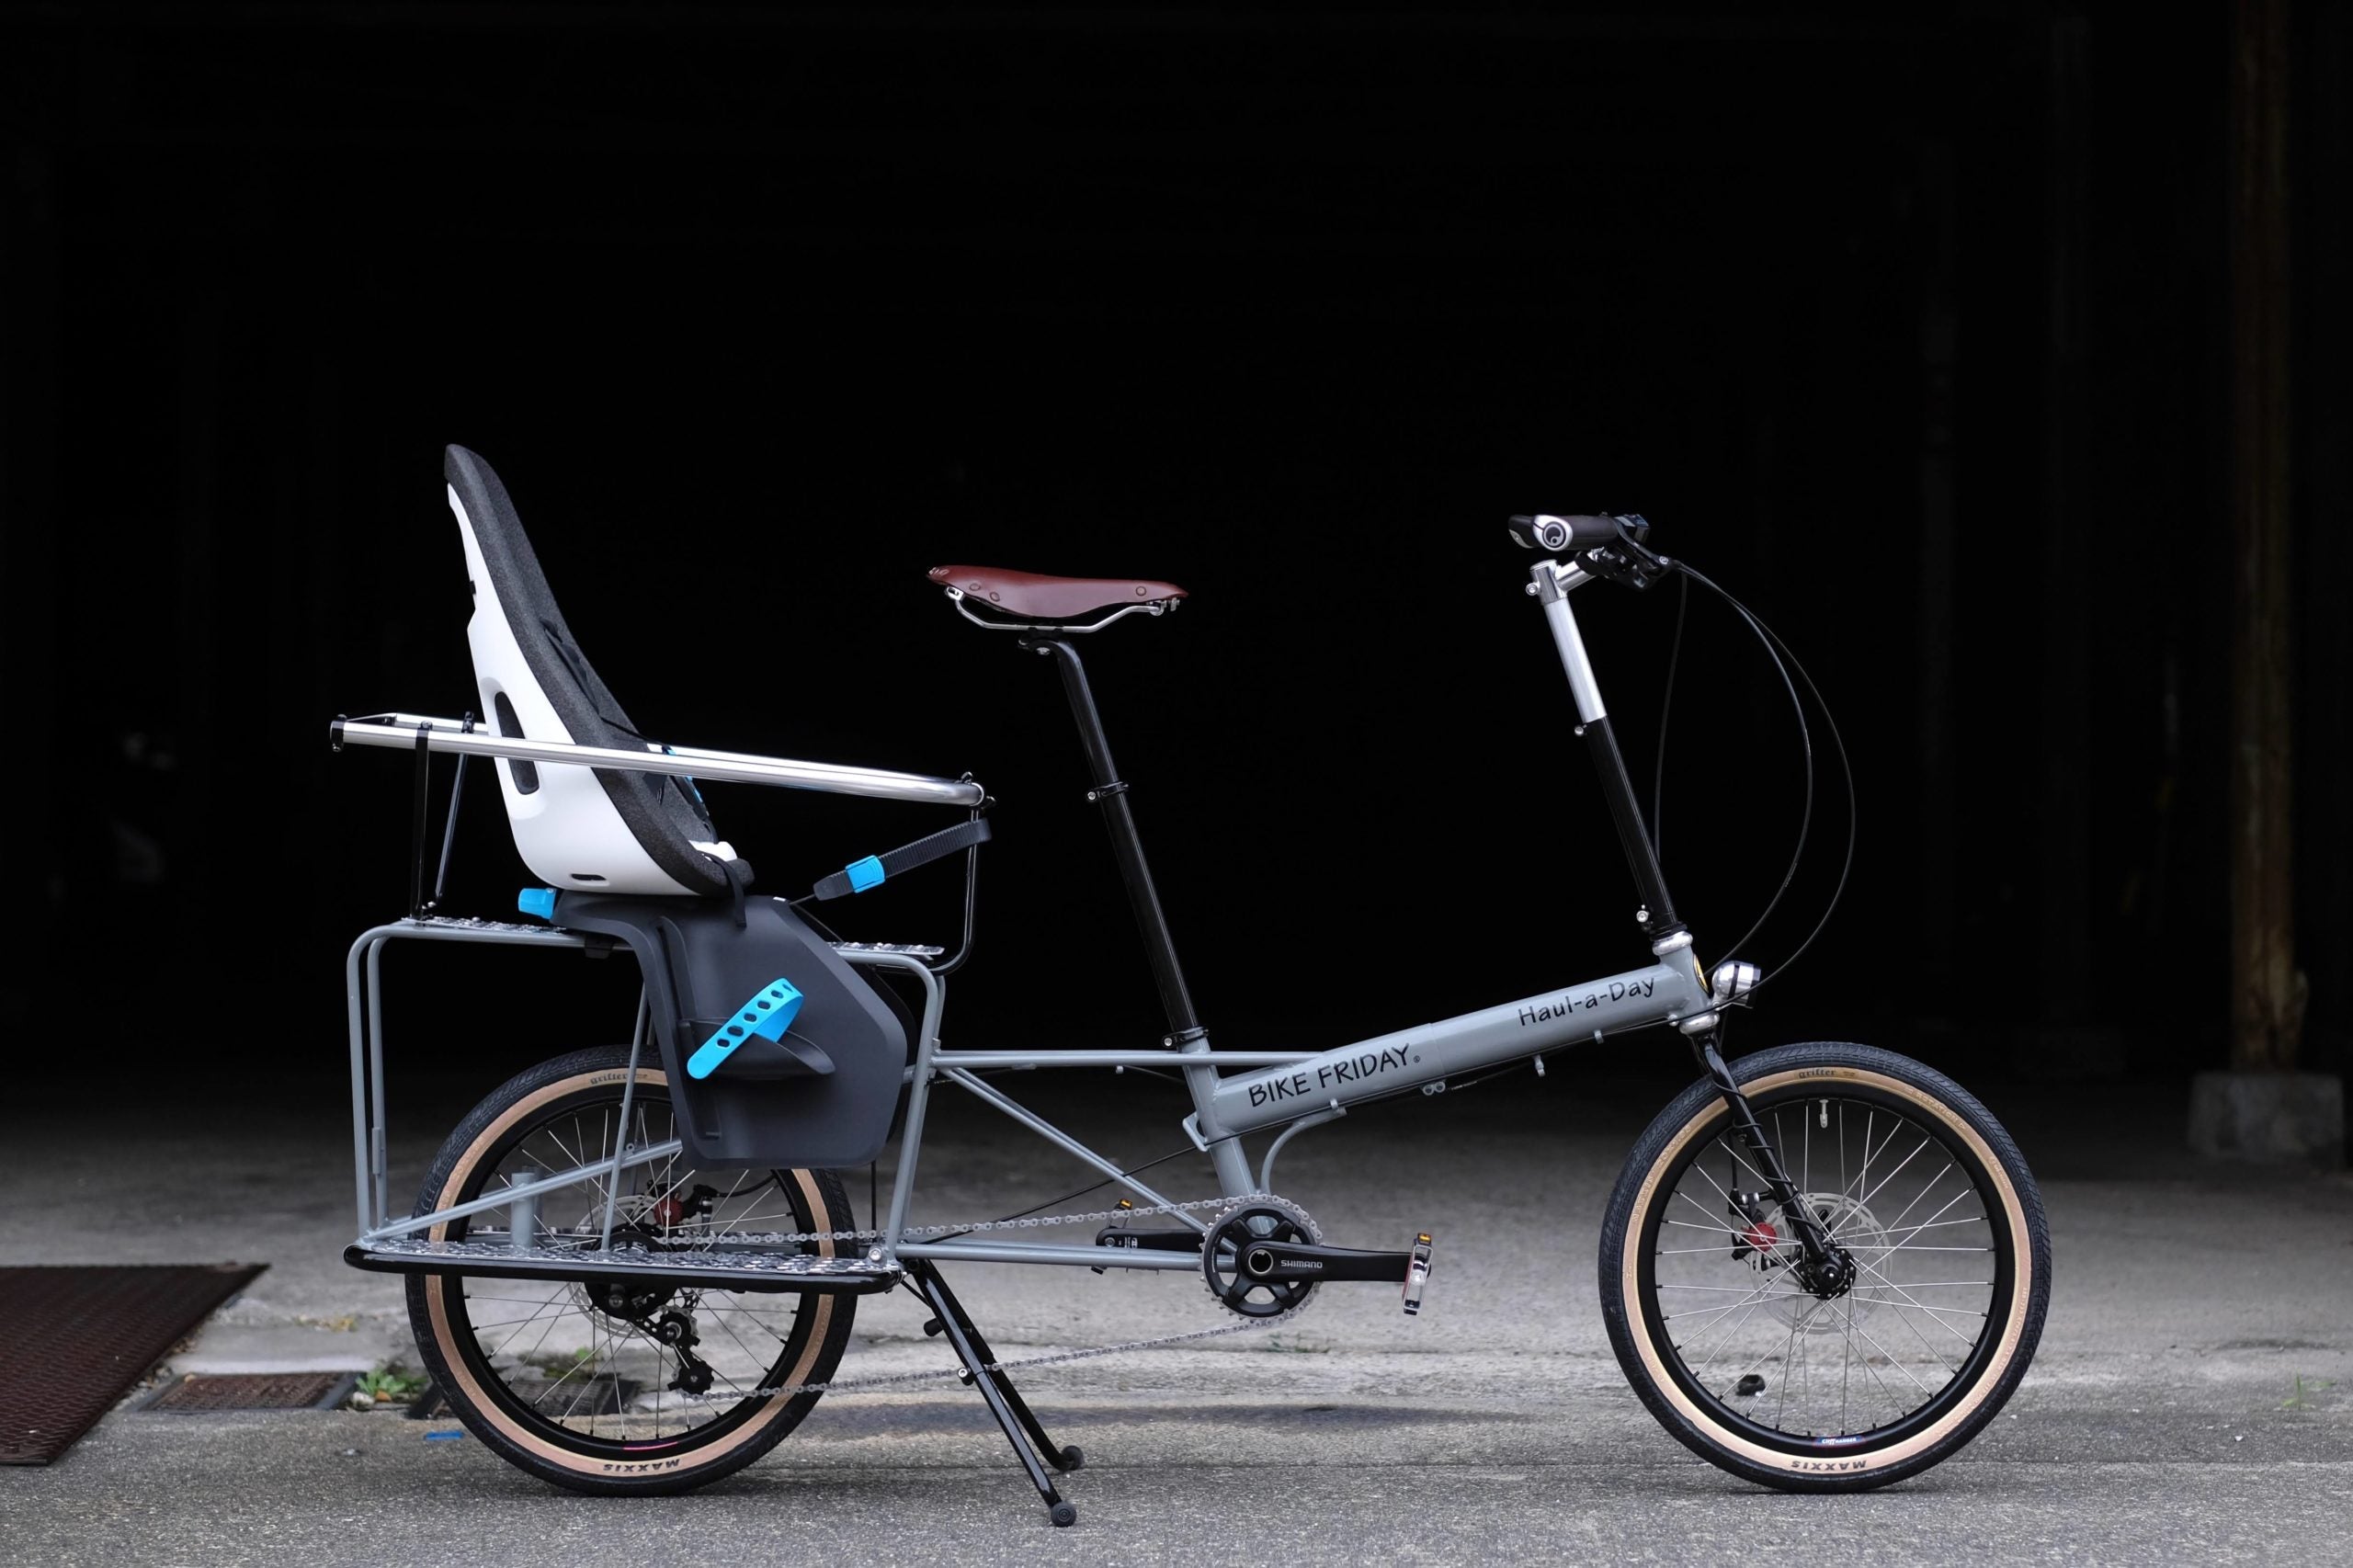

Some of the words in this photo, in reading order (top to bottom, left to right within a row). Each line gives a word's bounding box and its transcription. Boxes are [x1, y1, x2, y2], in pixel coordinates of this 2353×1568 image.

[1518, 977, 1654, 1026] Haul-a-Day
[1799, 1068, 1836, 1079] grifter
[1248, 1072, 1312, 1108] BIKE
[1280, 1259, 1323, 1268] SHIMANO
[603, 1459, 680, 1472] MAXXIS
[1790, 1460, 1867, 1471] MAXXIS
